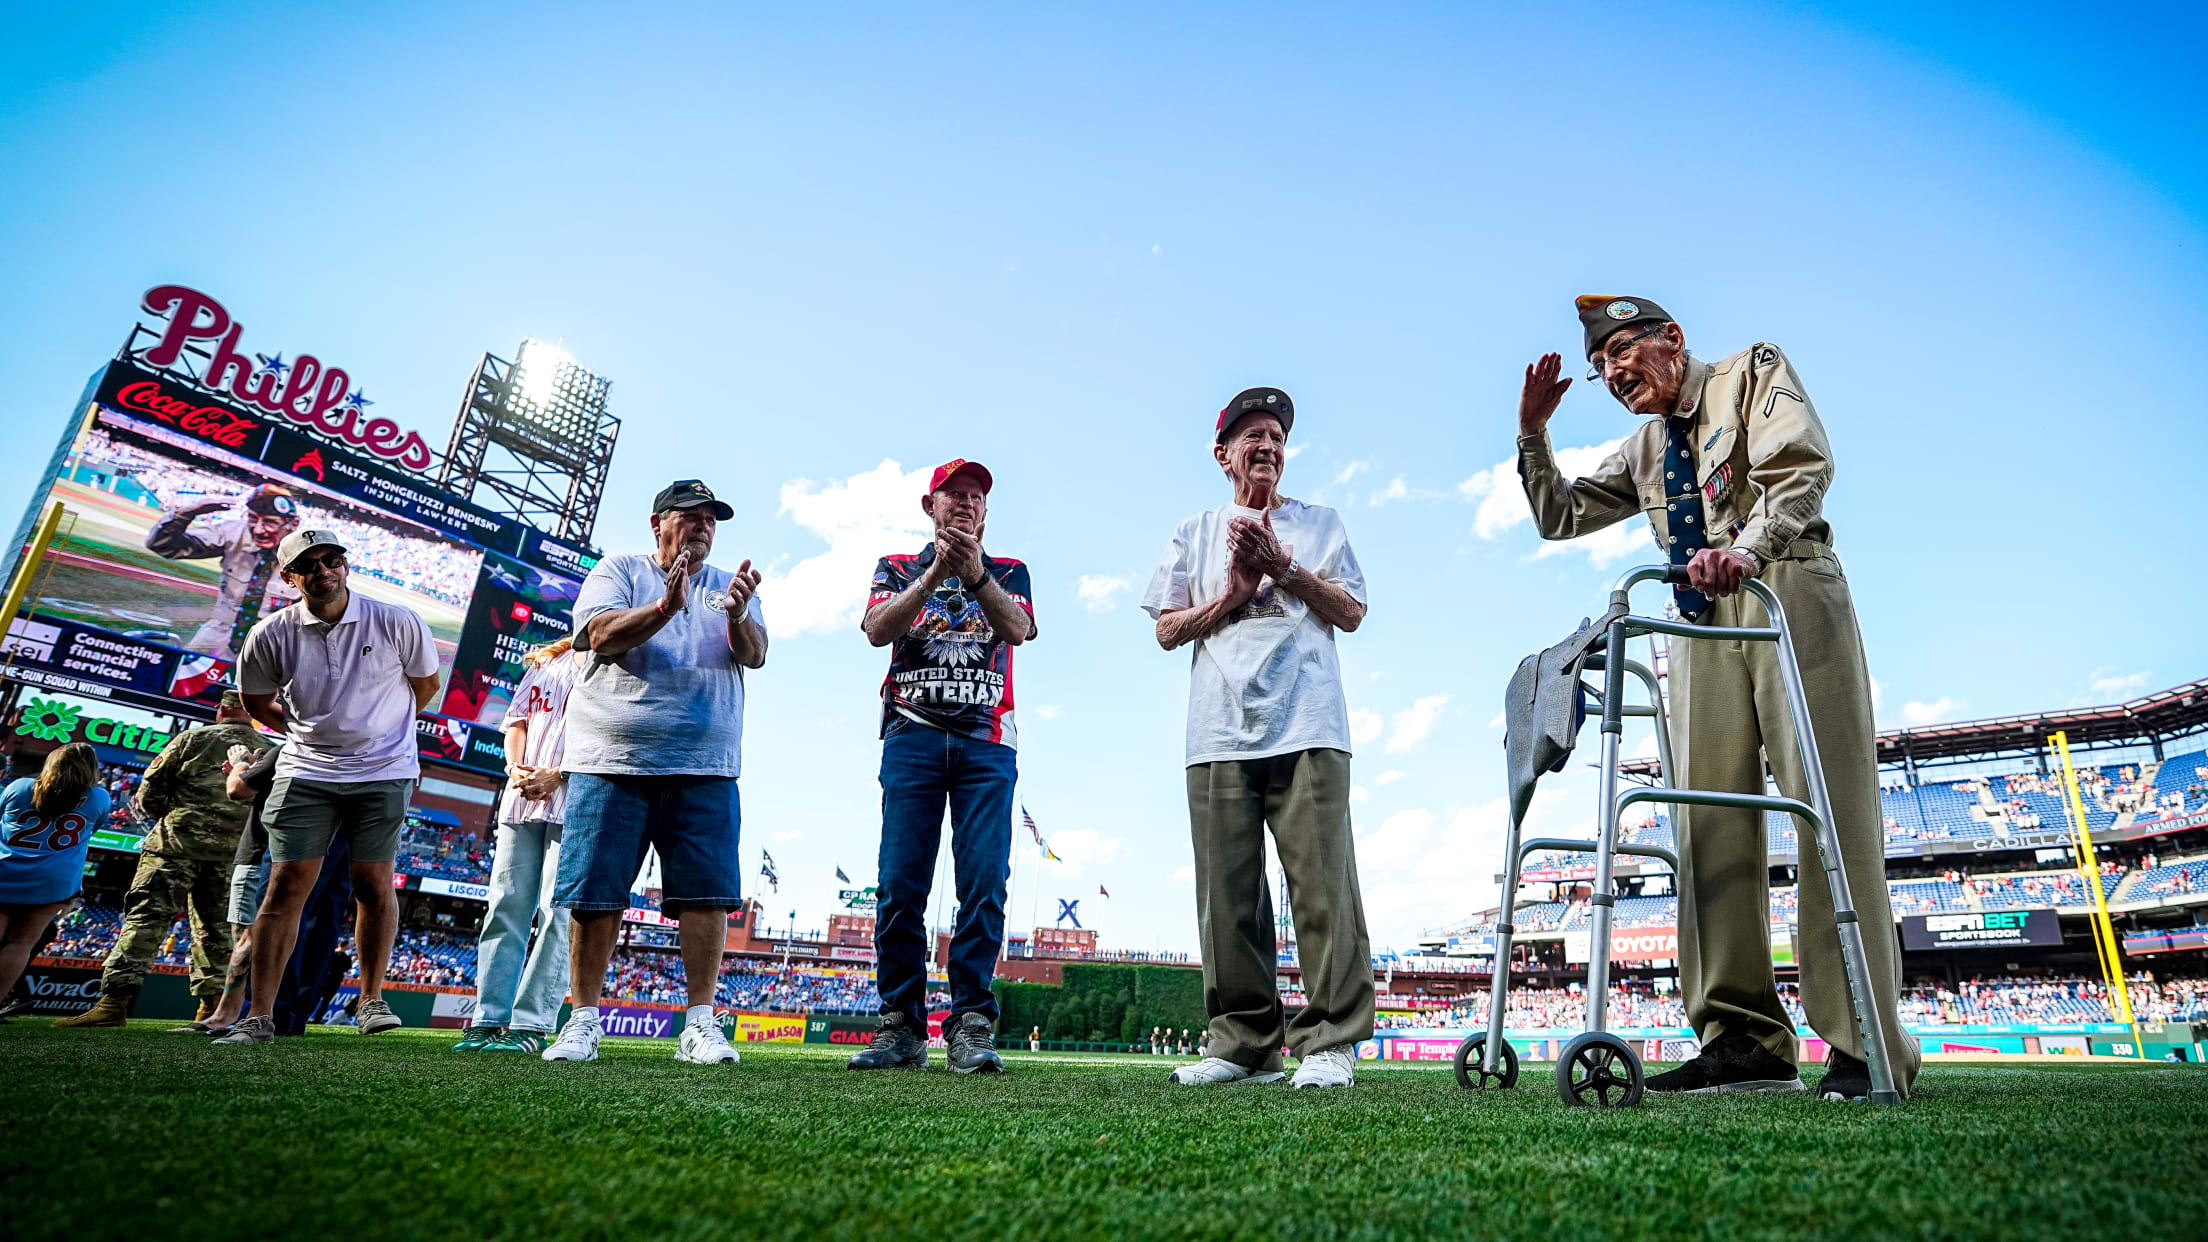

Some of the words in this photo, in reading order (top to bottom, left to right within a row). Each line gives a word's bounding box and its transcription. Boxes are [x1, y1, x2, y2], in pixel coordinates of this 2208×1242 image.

[140, 284, 432, 472] Phillies
[117, 381, 259, 448] Coca-Cola
[331, 460, 368, 482] SALTZ
[371, 476, 445, 511] MONGELUZZI
[446, 504, 501, 533] BENDESKY
[363, 484, 409, 508] INJURY
[416, 505, 468, 531] LAWYERS
[540, 540, 581, 565] ESPN
[546, 554, 592, 576] SPORTSBO
[532, 612, 569, 632] TOYOTA
[68, 644, 139, 670] financial
[74, 632, 164, 665] Connecting
[62, 657, 133, 681] services.
[895, 667, 948, 683] UNITED
[953, 667, 1004, 685] STATES
[44, 674, 77, 690] SQUAD
[78, 681, 112, 697] WITHIN
[900, 680, 1004, 708] VETERAN
[7, 808, 87, 852] 28
[2144, 818, 2187, 834] ARMED
[1972, 833, 2073, 850] CADILLA
[1926, 913, 1984, 932] ESPN
[1984, 911, 2030, 929] BET
[1610, 935, 1677, 953] OYOTA
[1939, 929, 2021, 941] SPORTSBOOK
[810, 1022, 827, 1033] 387
[1418, 1042, 1460, 1057] Temple
[2111, 1043, 2133, 1056] 330
